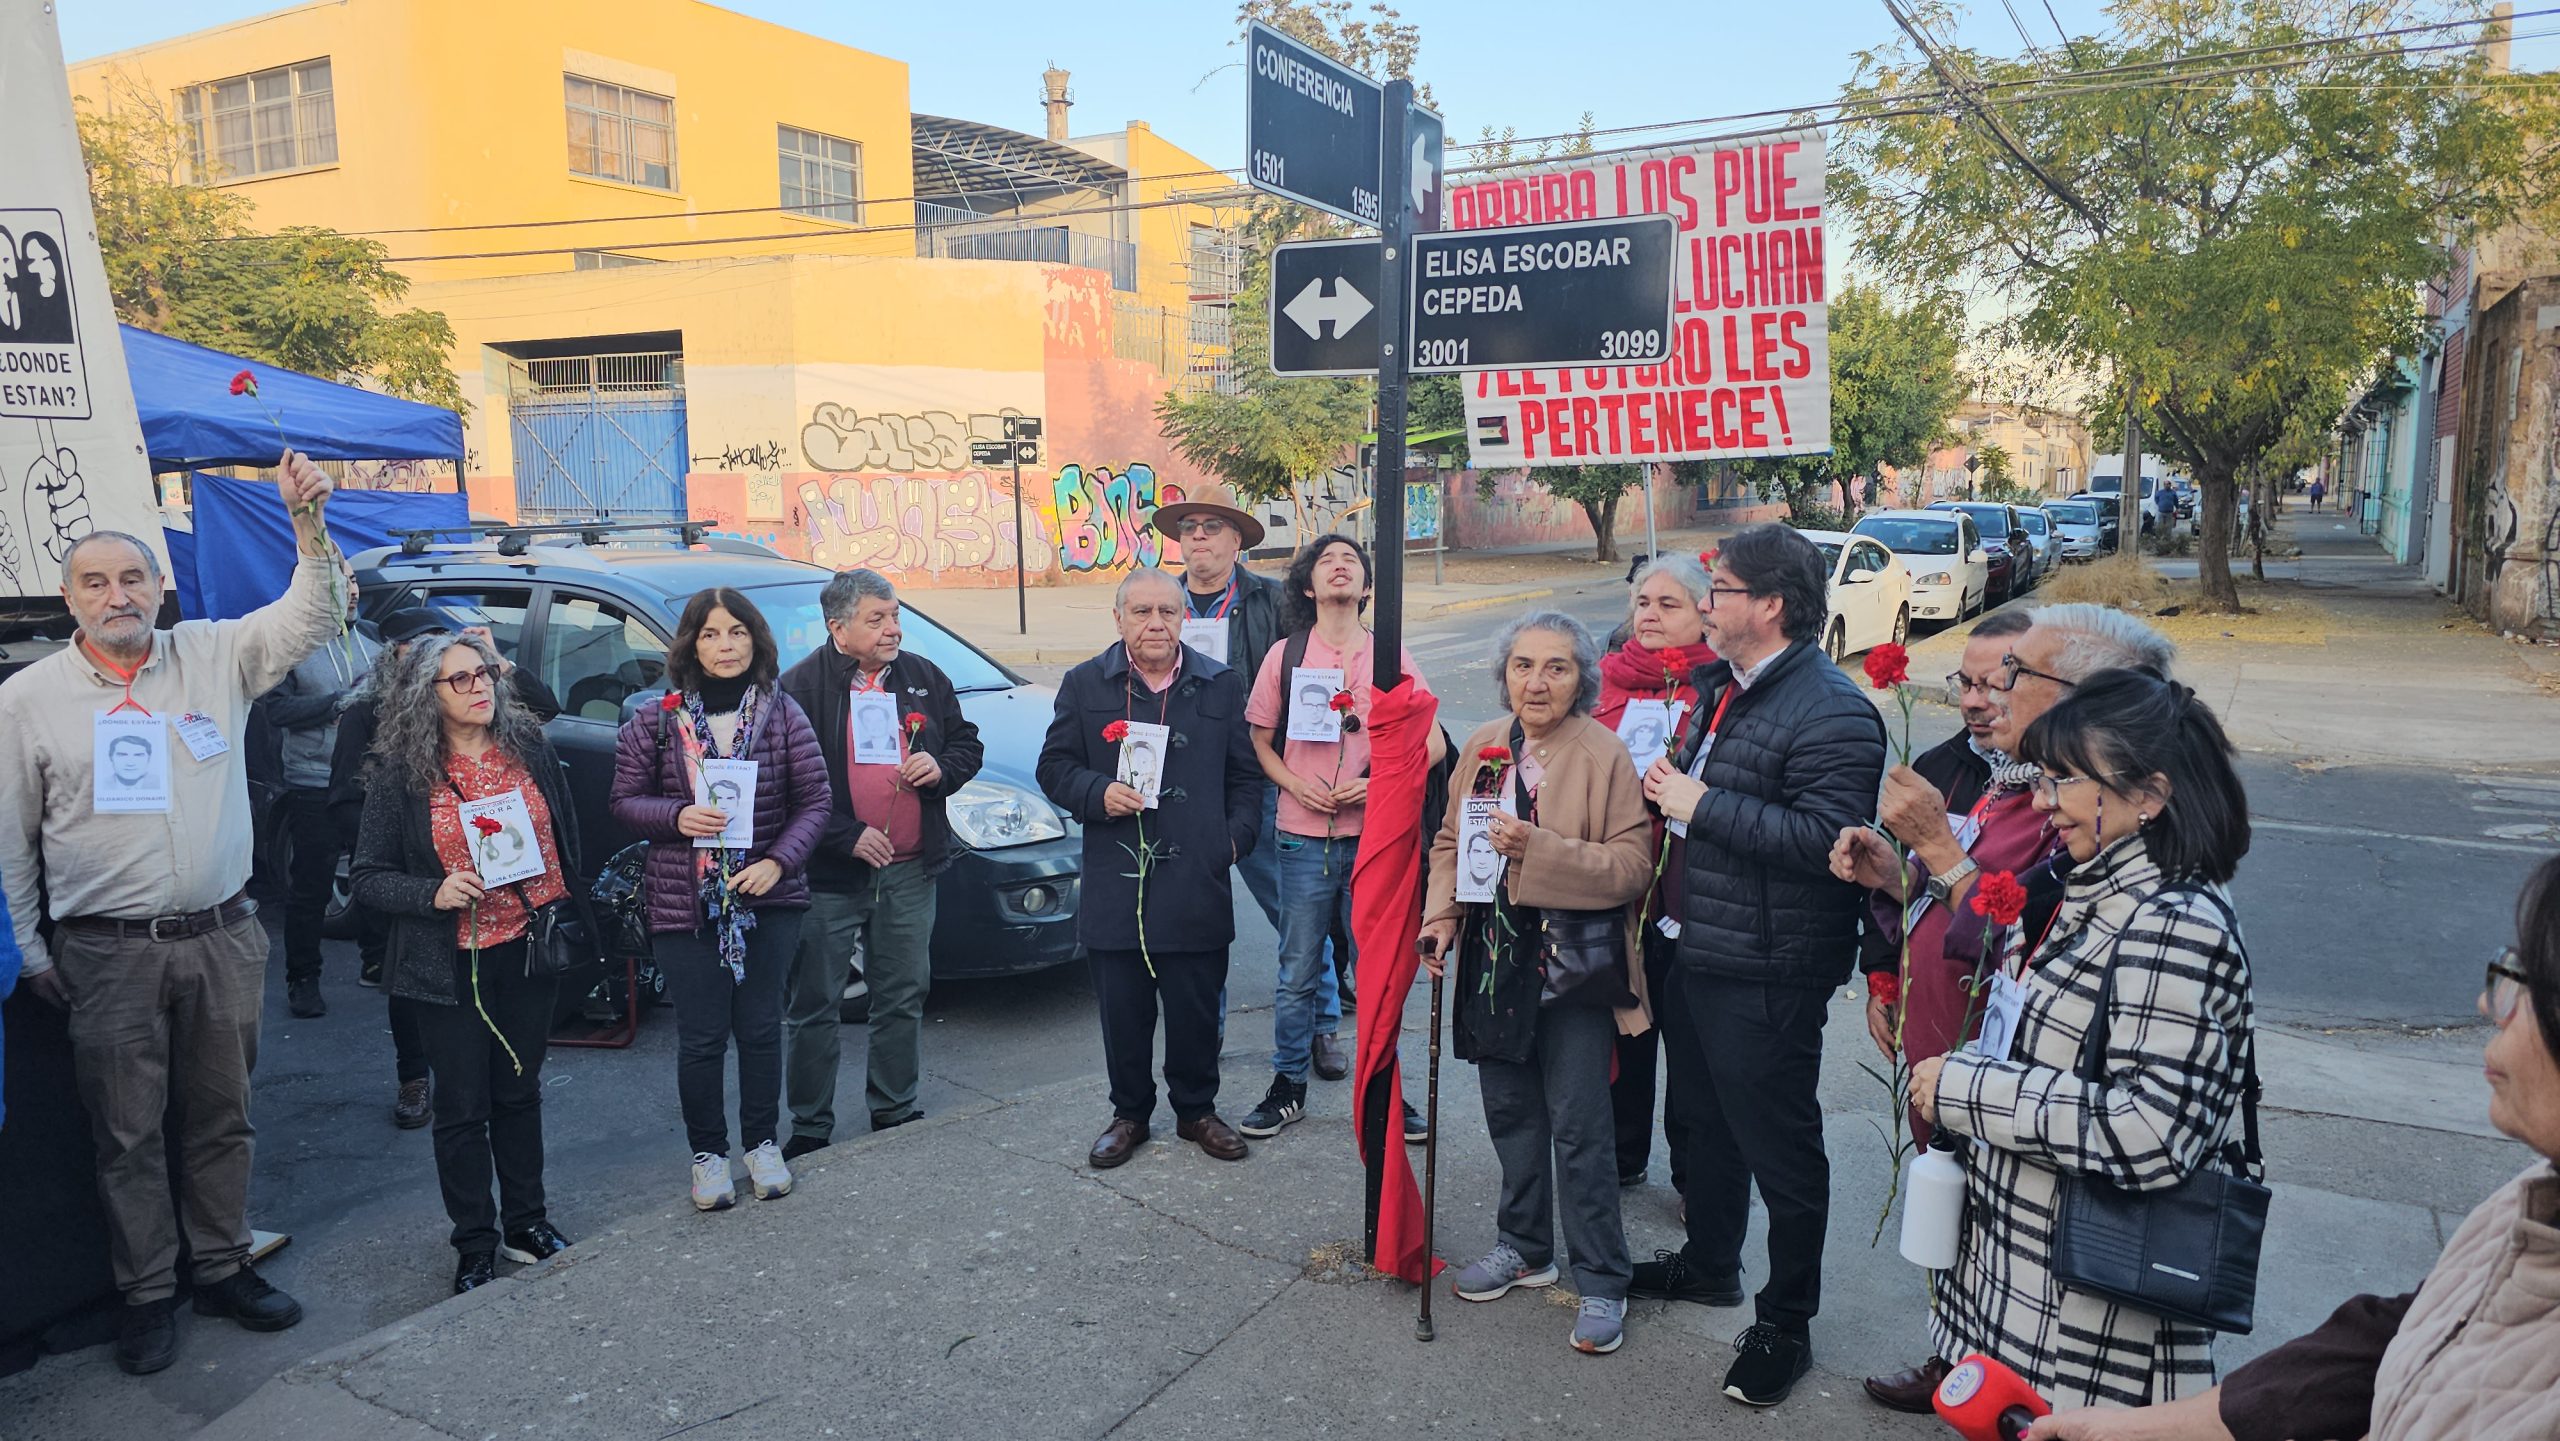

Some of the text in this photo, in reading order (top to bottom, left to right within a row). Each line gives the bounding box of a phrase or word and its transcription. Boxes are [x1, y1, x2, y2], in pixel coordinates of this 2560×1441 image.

[1257, 44, 1354, 117] CONFERENCIA
[1255, 149, 1285, 186] 1501
[1352, 186, 1378, 221] 1595
[1426, 237, 1631, 277] ELISA ESCOBAR
[1423, 284, 1523, 316] CEPEDA
[1418, 329, 1660, 366] 3001 3099
[1723, 311, 1811, 382] LES
[3, 385, 76, 407] ESTAN?
[1518, 385, 1793, 458] PERTENECE!
